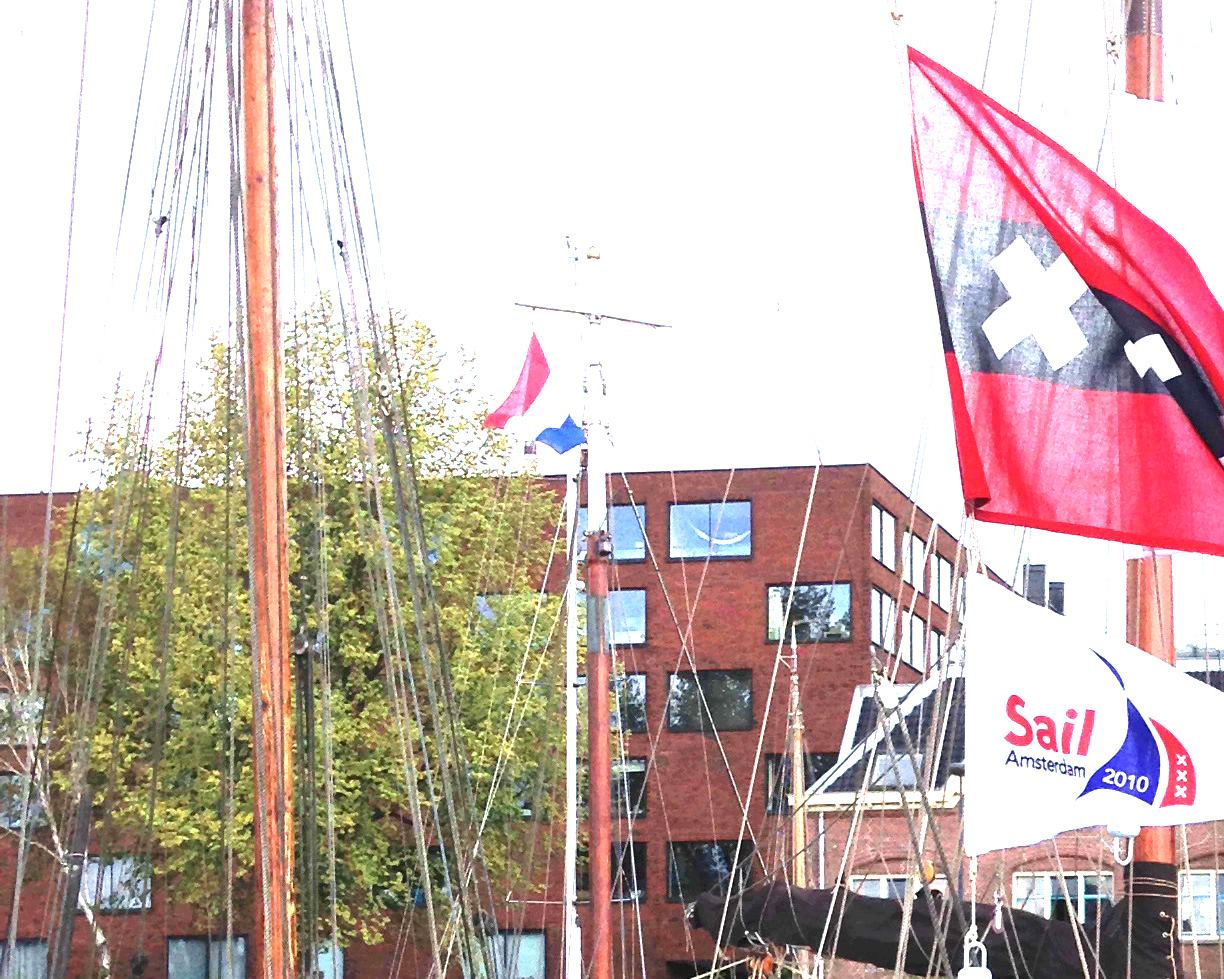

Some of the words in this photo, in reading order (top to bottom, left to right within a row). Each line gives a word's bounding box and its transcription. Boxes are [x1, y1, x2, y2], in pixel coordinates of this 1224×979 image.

[1004, 694, 1095, 757] Sail
[1005, 750, 1086, 778] Amsterdam
[1102, 768, 1149, 793] 2010
